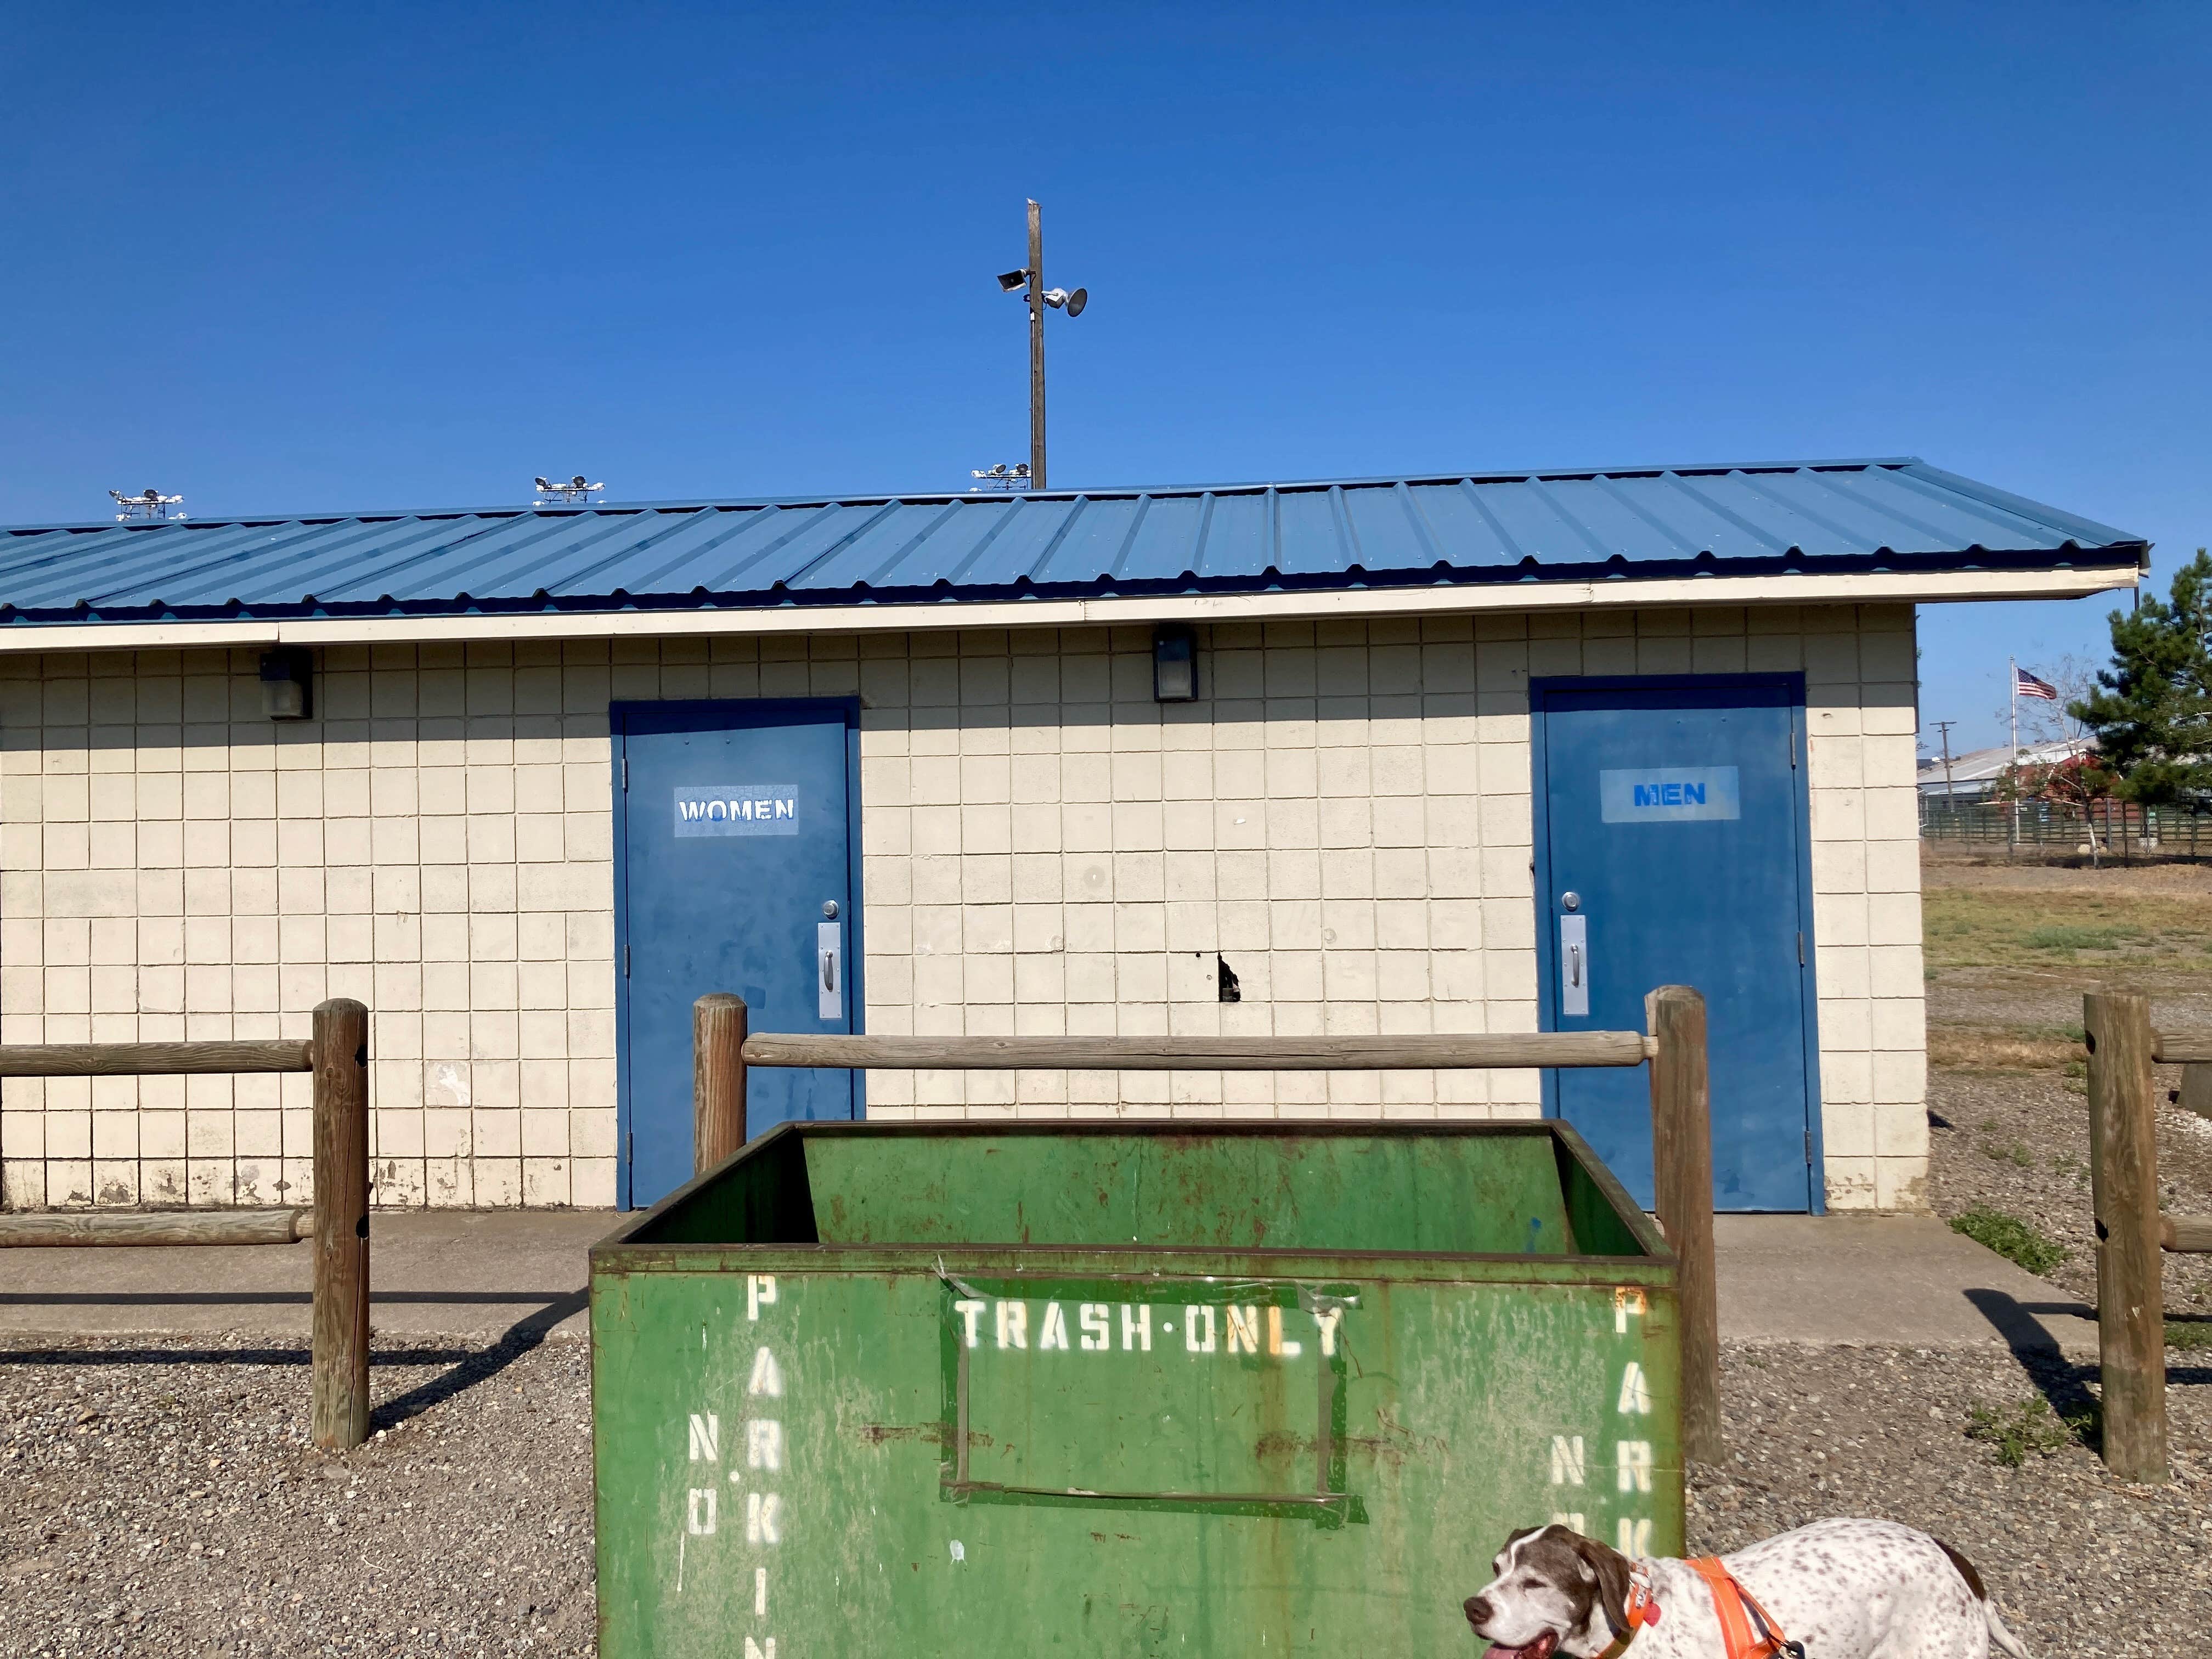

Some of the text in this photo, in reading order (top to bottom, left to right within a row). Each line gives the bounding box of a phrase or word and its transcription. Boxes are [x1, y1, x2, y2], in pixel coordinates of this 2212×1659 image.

[679, 798, 794, 822] WOMEN
[1633, 782, 1706, 806] MEN
[954, 1300, 1343, 1356] TRASH ONLY
[688, 1413, 718, 1534] NO
